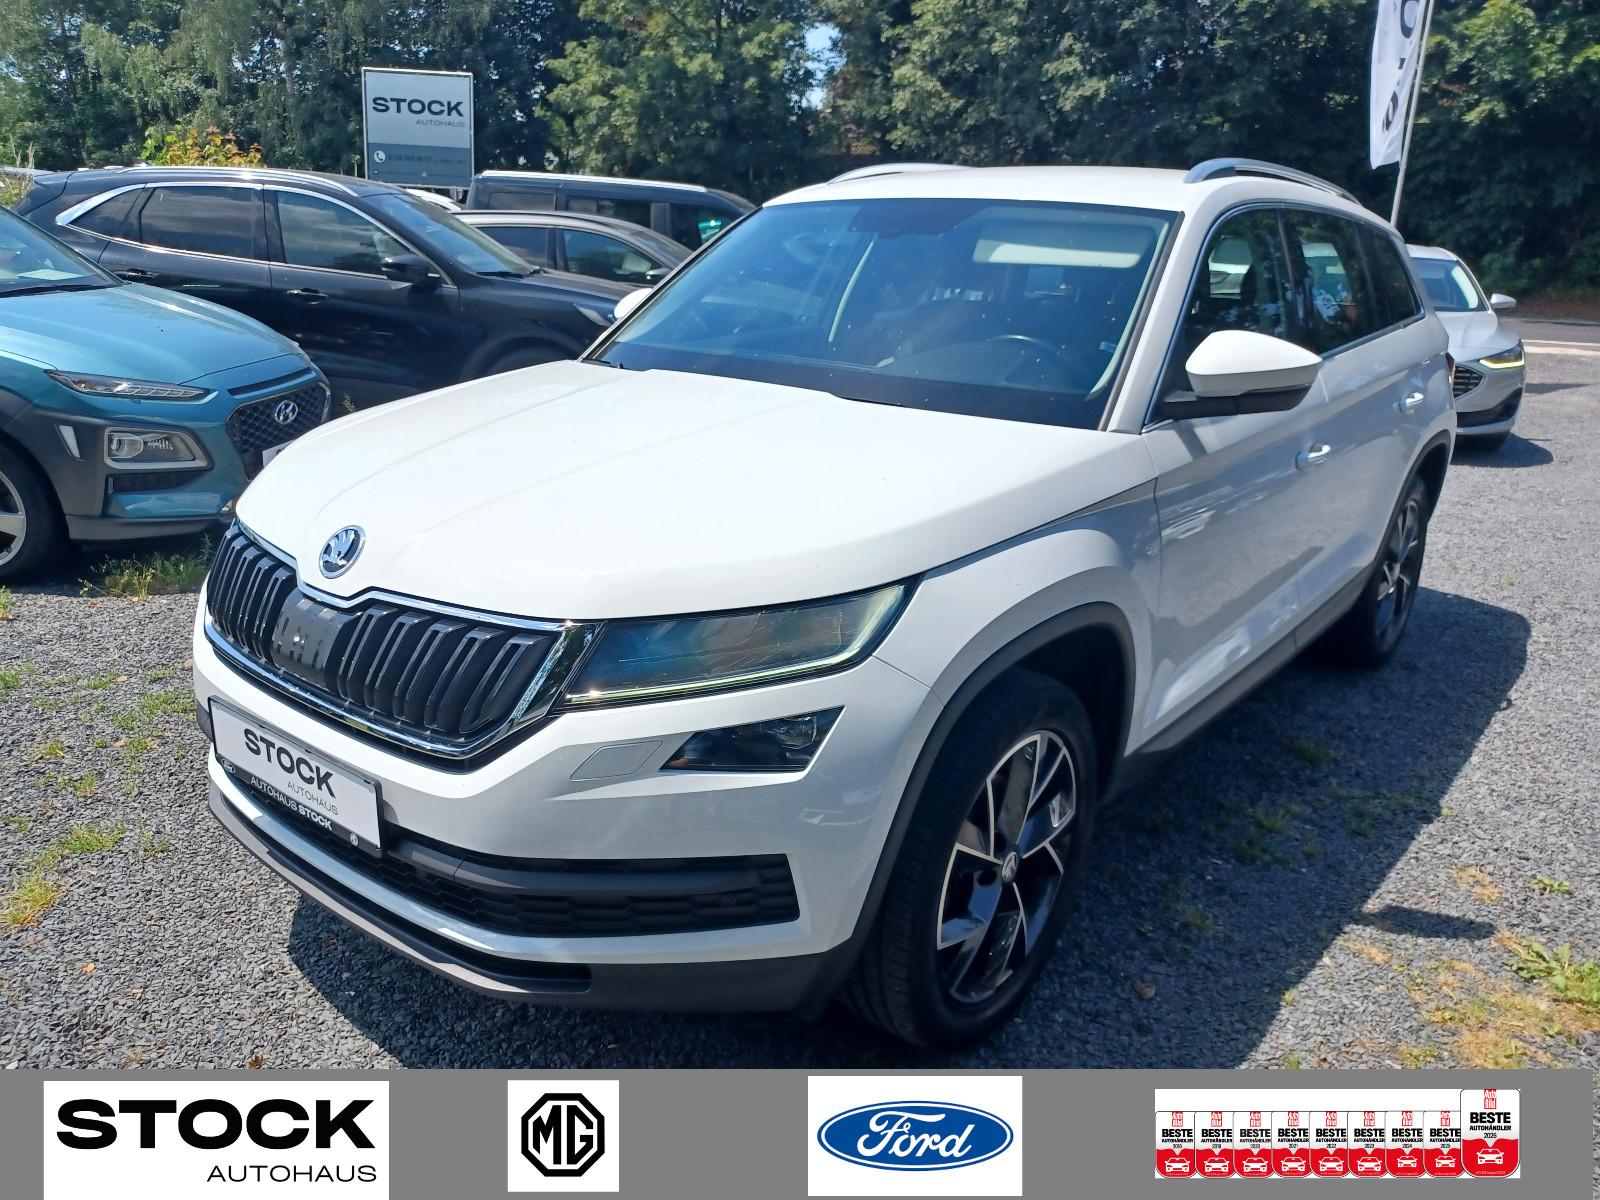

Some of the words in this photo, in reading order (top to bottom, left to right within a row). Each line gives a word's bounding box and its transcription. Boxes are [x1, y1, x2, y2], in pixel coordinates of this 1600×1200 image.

[372, 96, 464, 117] STOCK
[416, 119, 465, 128] AUTOHAUS
[243, 728, 336, 799] STOCK
[250, 776, 298, 811] AUTOHAUS
[298, 804, 333, 831] STOCK
[287, 781, 339, 816] AUTOHAUS
